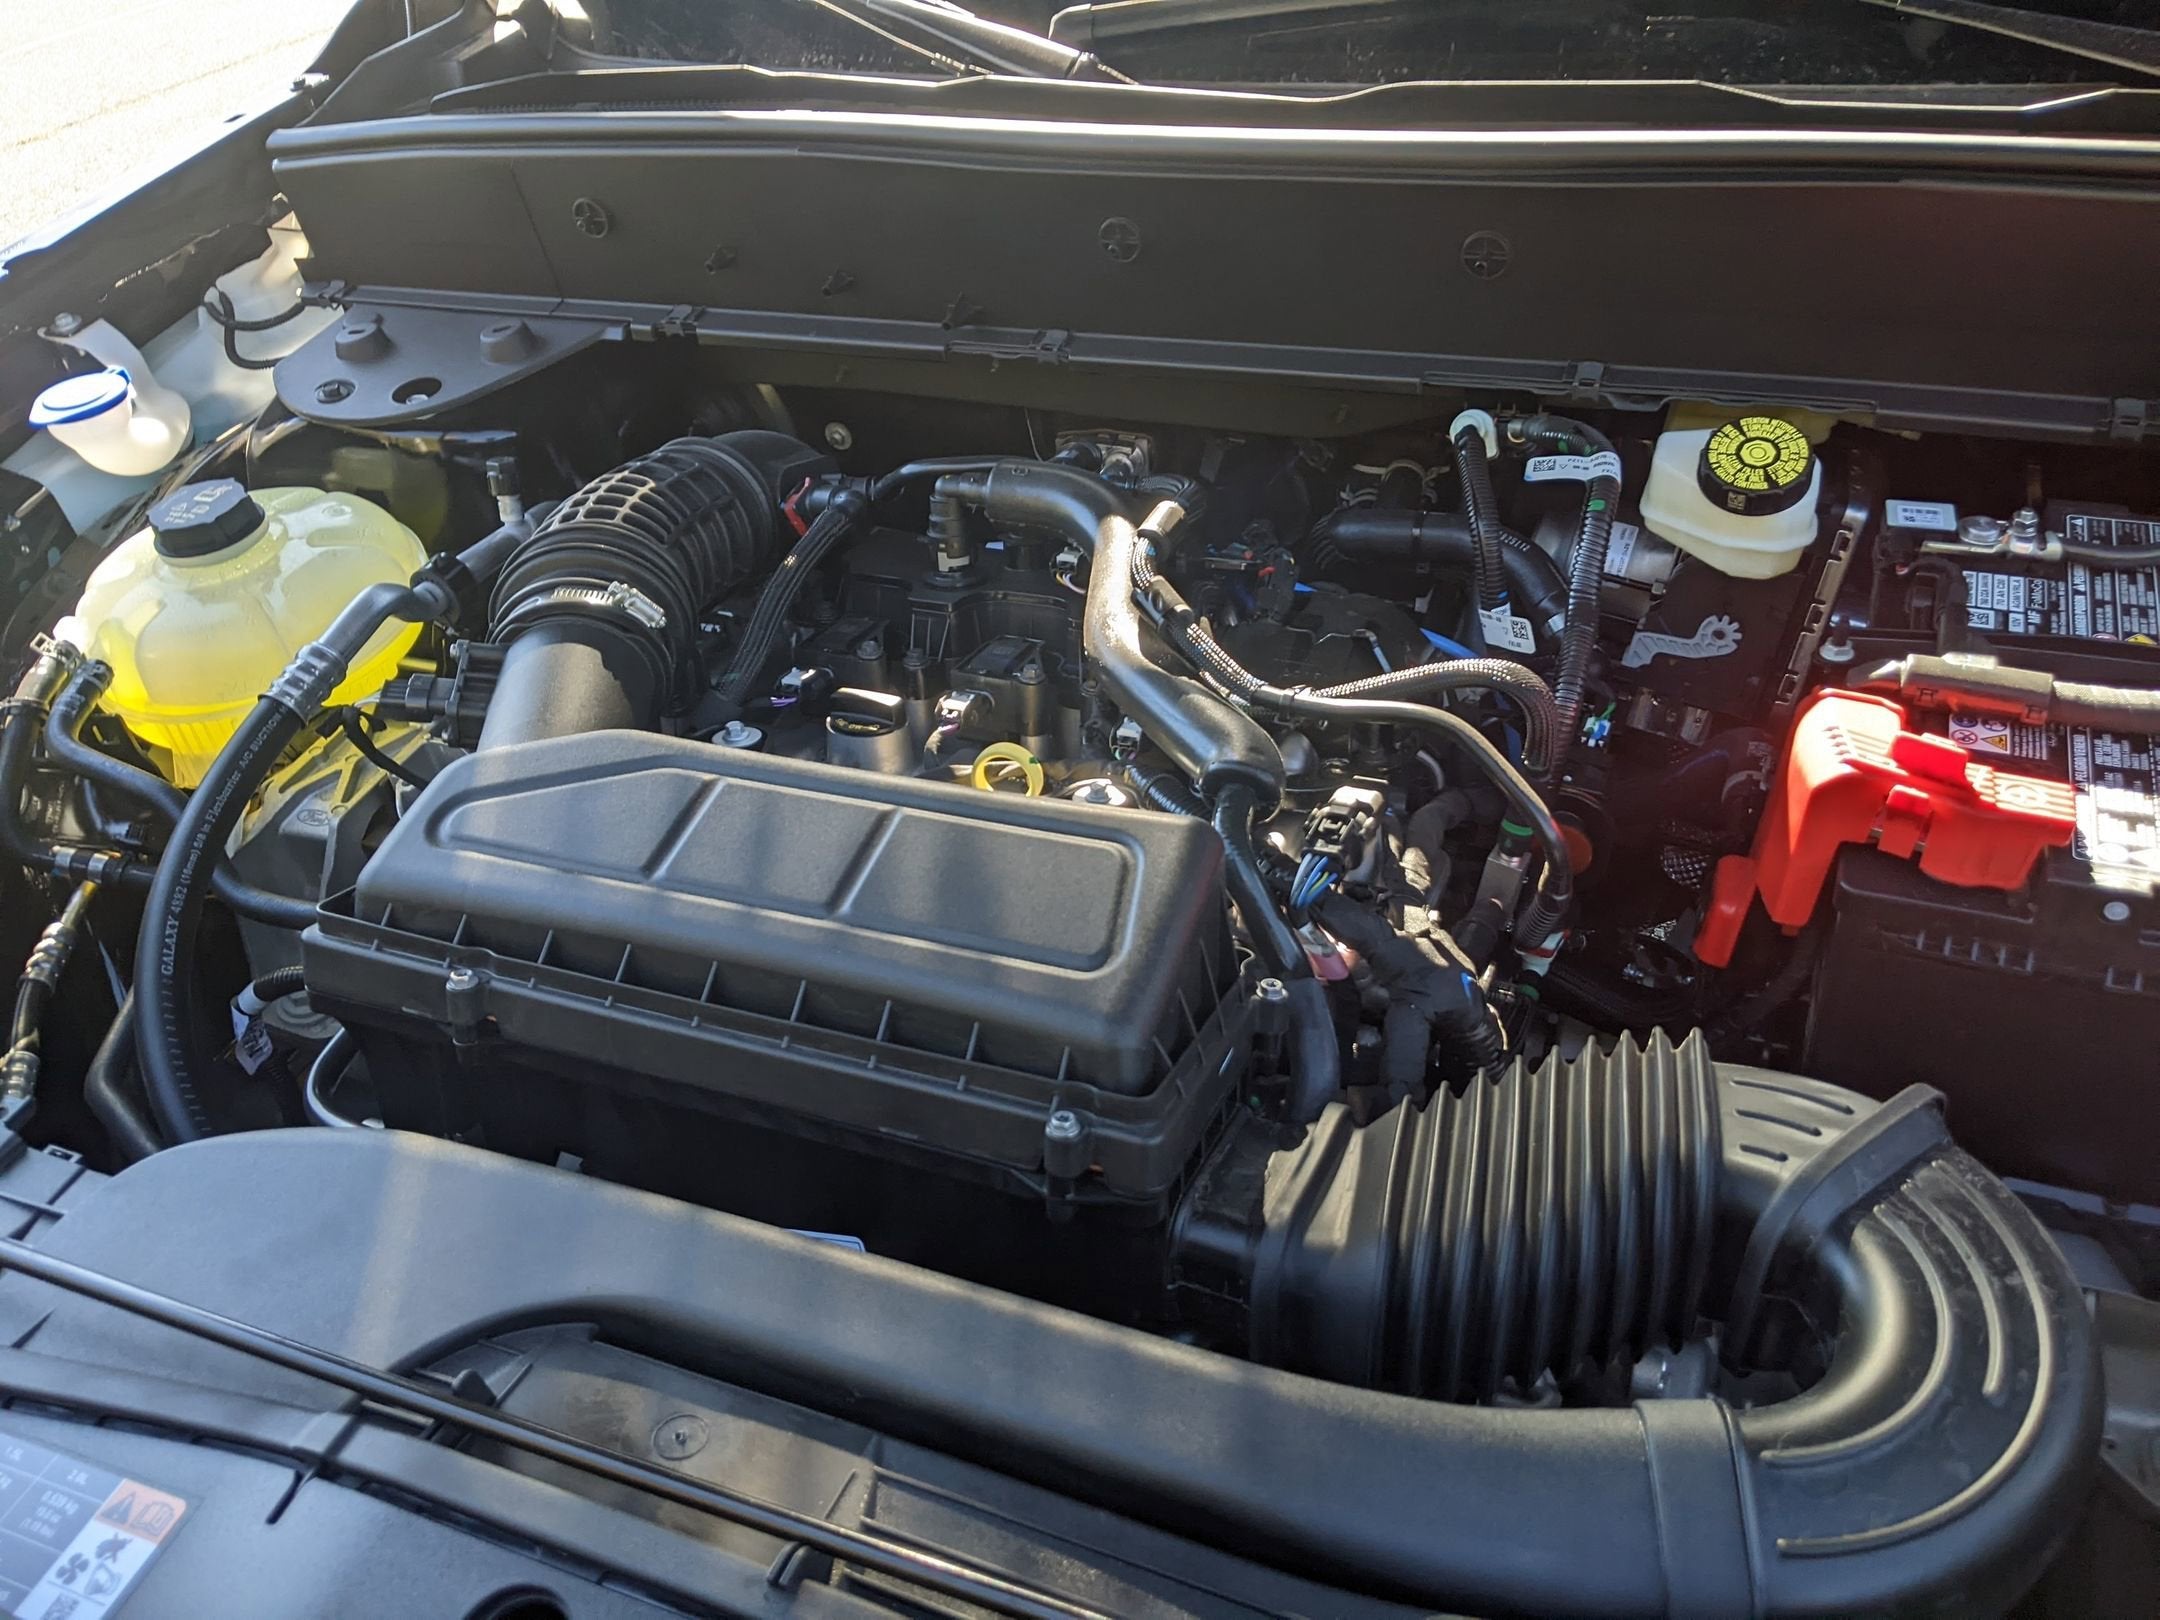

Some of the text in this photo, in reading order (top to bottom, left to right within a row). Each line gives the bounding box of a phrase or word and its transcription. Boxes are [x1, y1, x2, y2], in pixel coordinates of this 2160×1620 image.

[2031, 580, 2044, 609] FoMoCo
[2028, 610, 2041, 624] MF
[2074, 756, 2087, 781] PELIGRO
[161, 914, 179, 975] GALAXY
[205, 770, 241, 823] Flexbarrier
[239, 750, 253, 769] A/C
[250, 713, 282, 752] SUCTION
